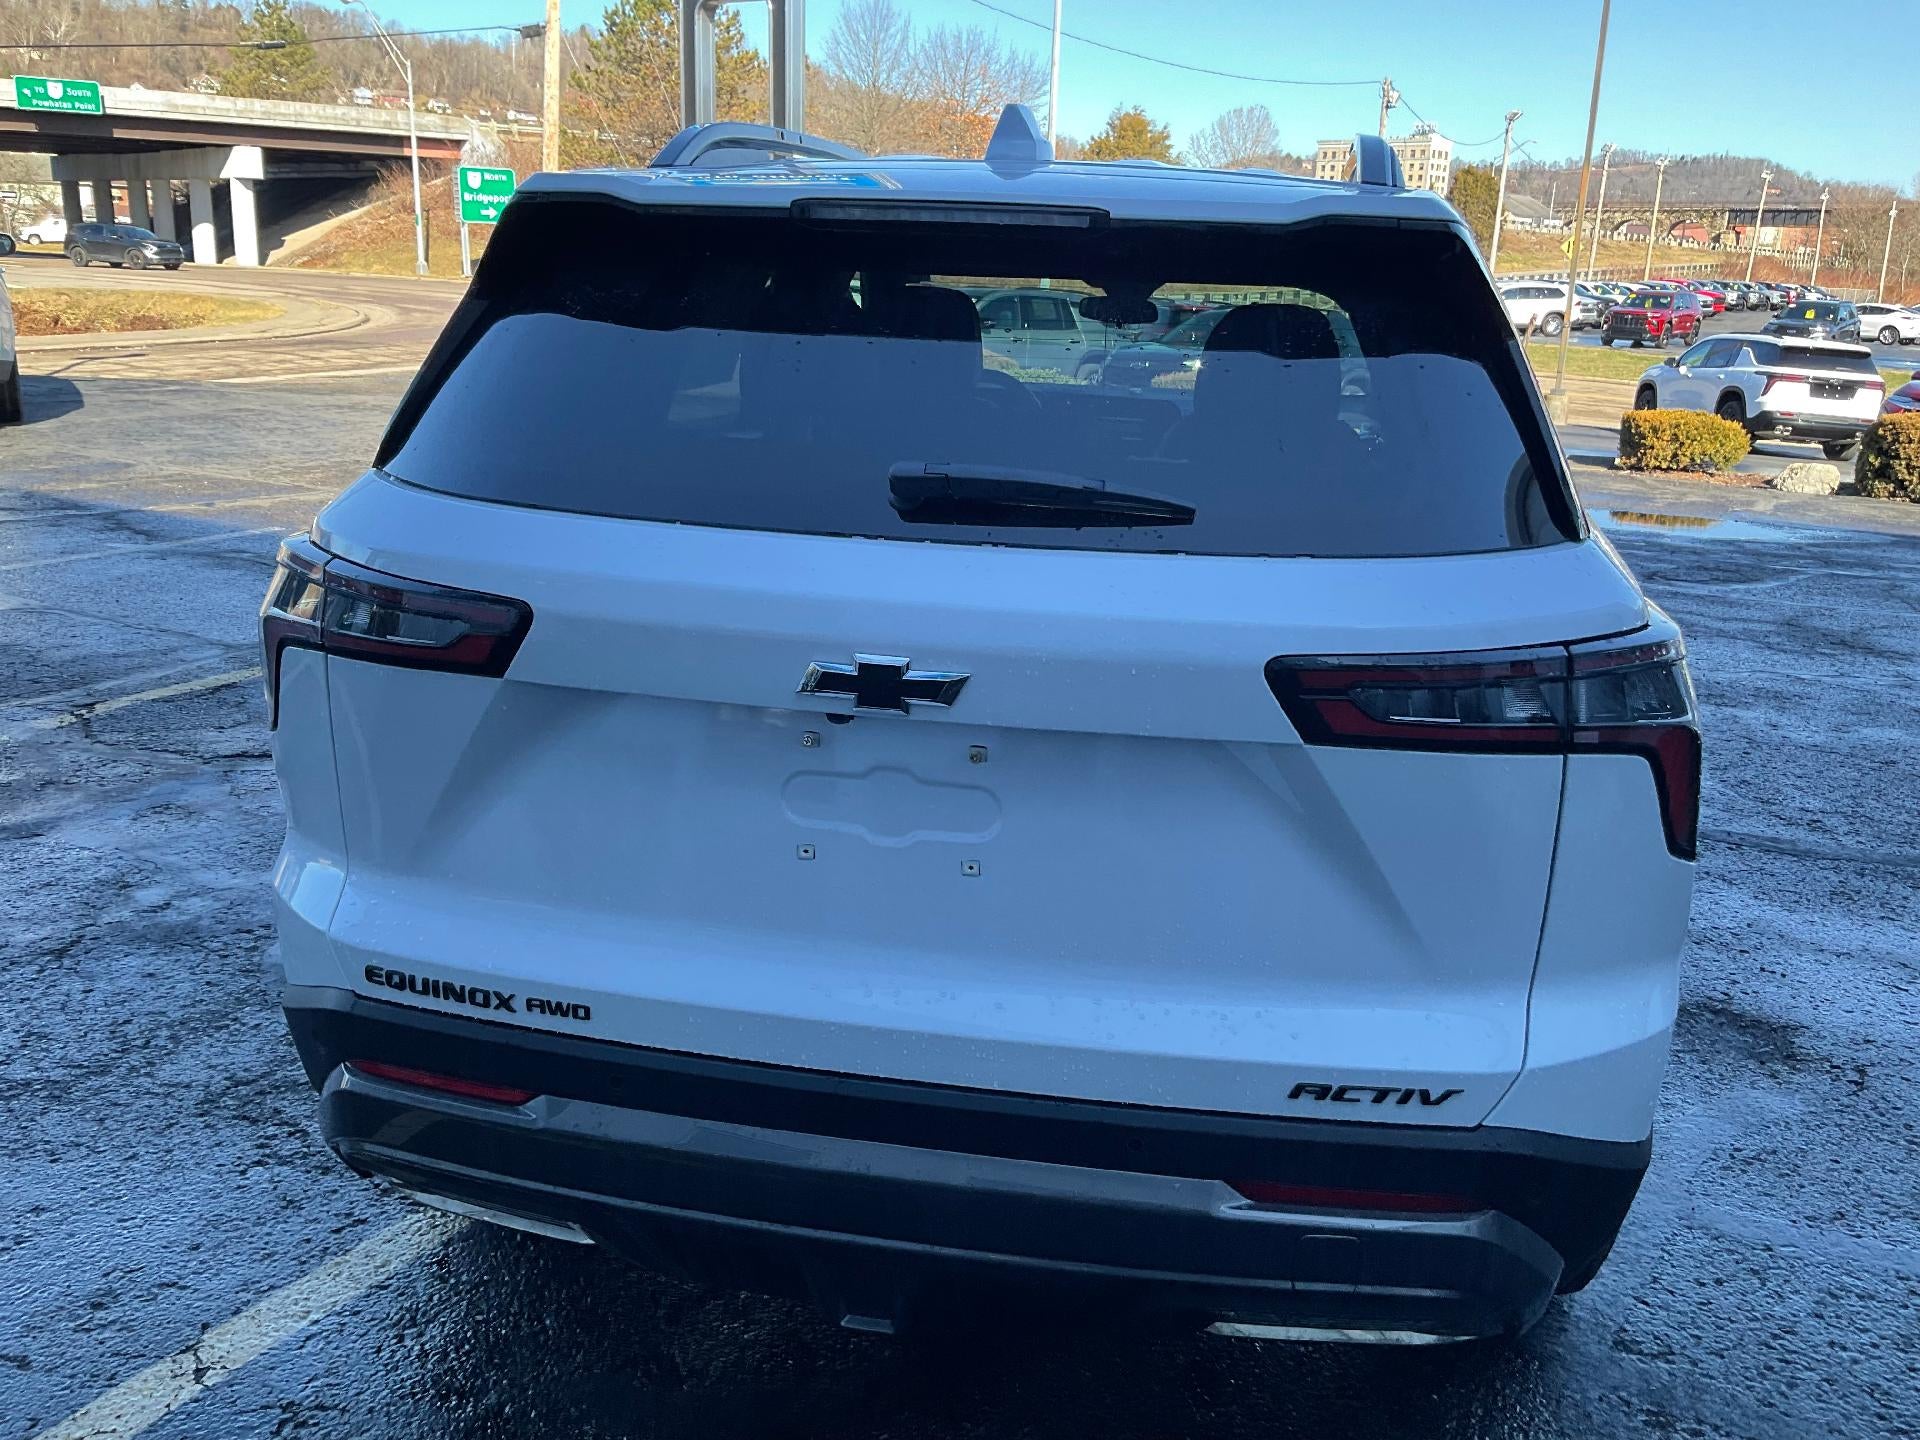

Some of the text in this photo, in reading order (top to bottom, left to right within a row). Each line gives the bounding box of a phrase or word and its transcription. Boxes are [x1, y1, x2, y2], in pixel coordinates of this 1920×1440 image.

[32, 99, 96, 111] Powhatan Point
[364, 964, 592, 1021] EQUINOX AWD
[1287, 1082, 1465, 1106] ACTIV
